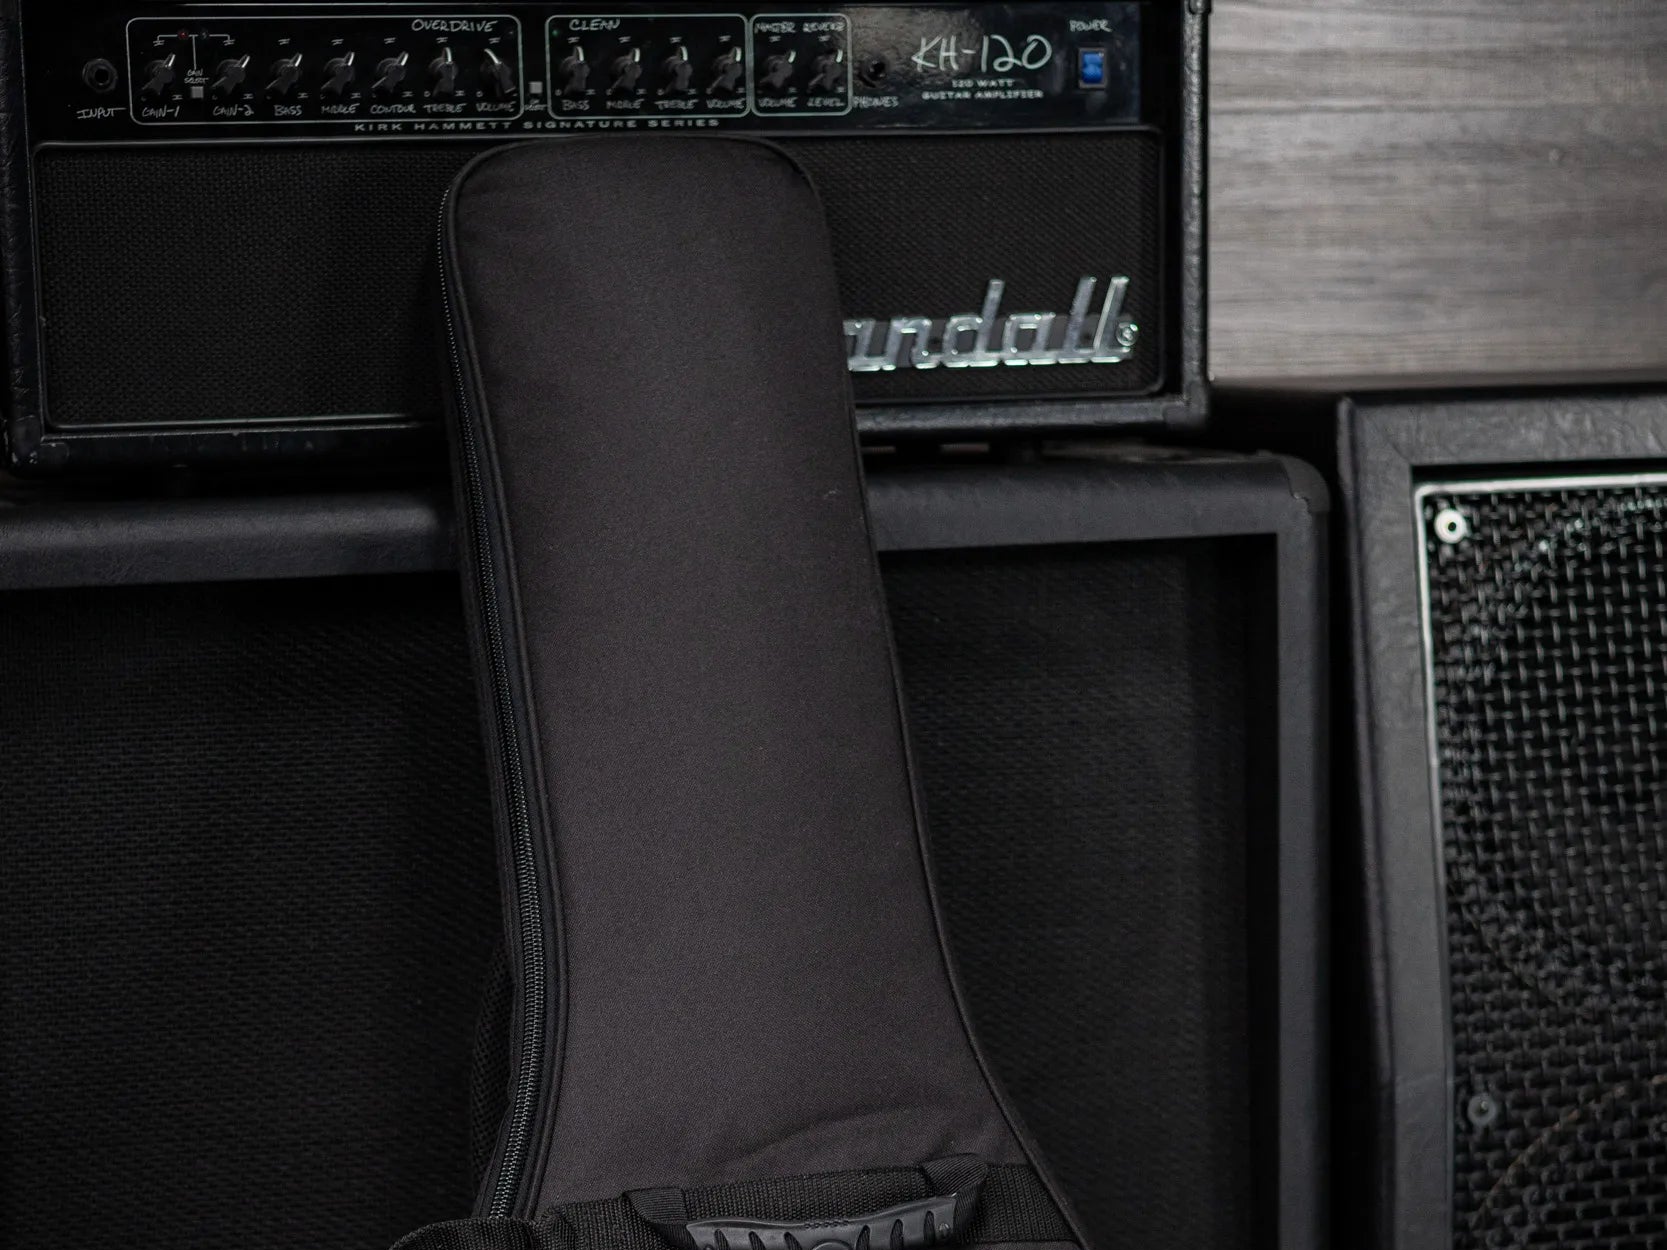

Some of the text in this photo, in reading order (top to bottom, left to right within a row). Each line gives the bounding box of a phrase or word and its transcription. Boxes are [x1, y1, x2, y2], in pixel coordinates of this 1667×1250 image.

[411, 19, 498, 32] OVERDRIVE
[569, 18, 621, 31] CLEAN
[1069, 19, 1113, 33] POWER
[911, 34, 1053, 73] KH-120
[976, 78, 1016, 88] WATT
[921, 89, 1044, 100] GUITAR AMPLIFIER
[562, 99, 590, 111] BASS
[806, 96, 845, 107] LEVEL
[77, 107, 126, 119] INPUT
[141, 105, 181, 118] GAIN-1
[213, 105, 254, 117] GAIN-2
[274, 105, 303, 116] BASS
[370, 103, 417, 114] CONTOUR
[354, 119, 720, 132] KIRK HAMMETT SIGNATURE SERIES
[842, 276, 1132, 372] andall
